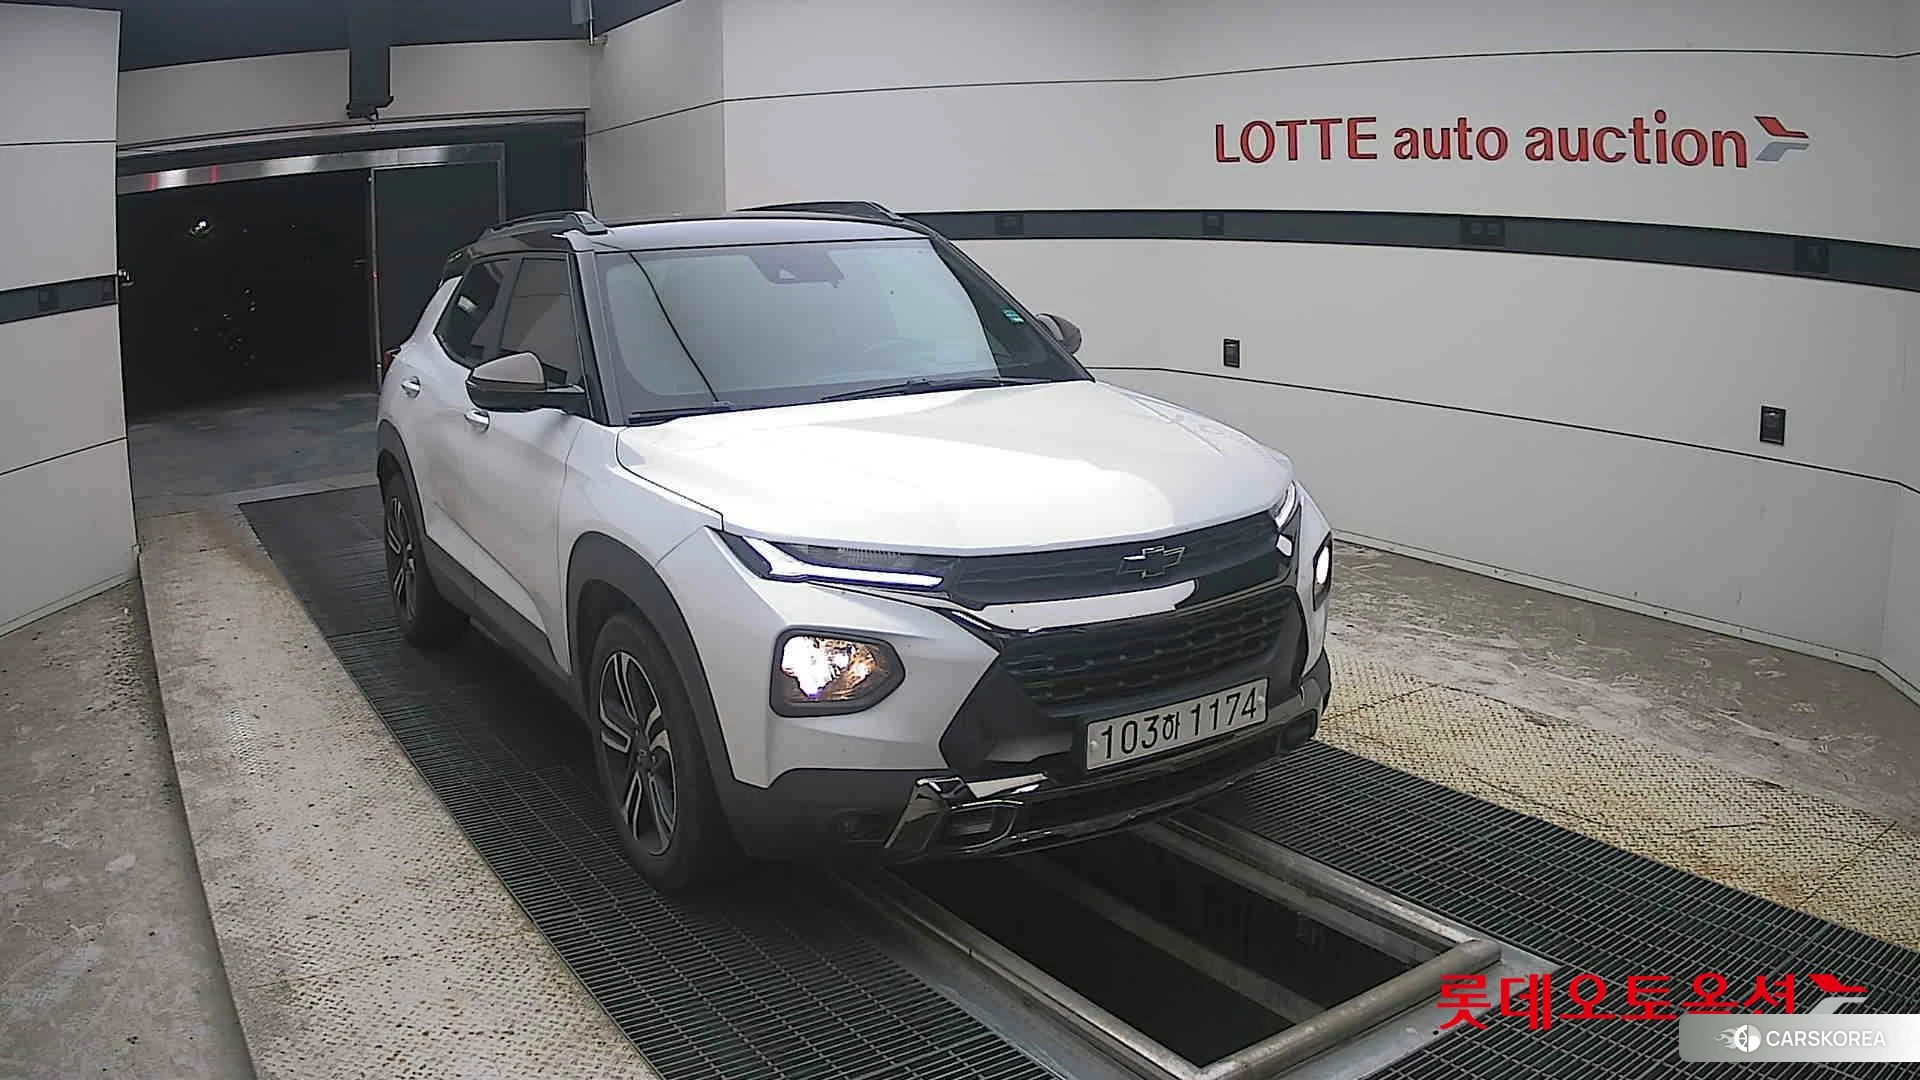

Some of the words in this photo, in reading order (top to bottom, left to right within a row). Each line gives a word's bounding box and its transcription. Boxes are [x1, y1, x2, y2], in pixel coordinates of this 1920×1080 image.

[1215, 116, 1378, 163] LOTTE
[1393, 117, 1509, 161] auto
[1525, 109, 1748, 168] auction
[1101, 711, 1181, 759] 103하
[1190, 687, 1257, 737] 1174
